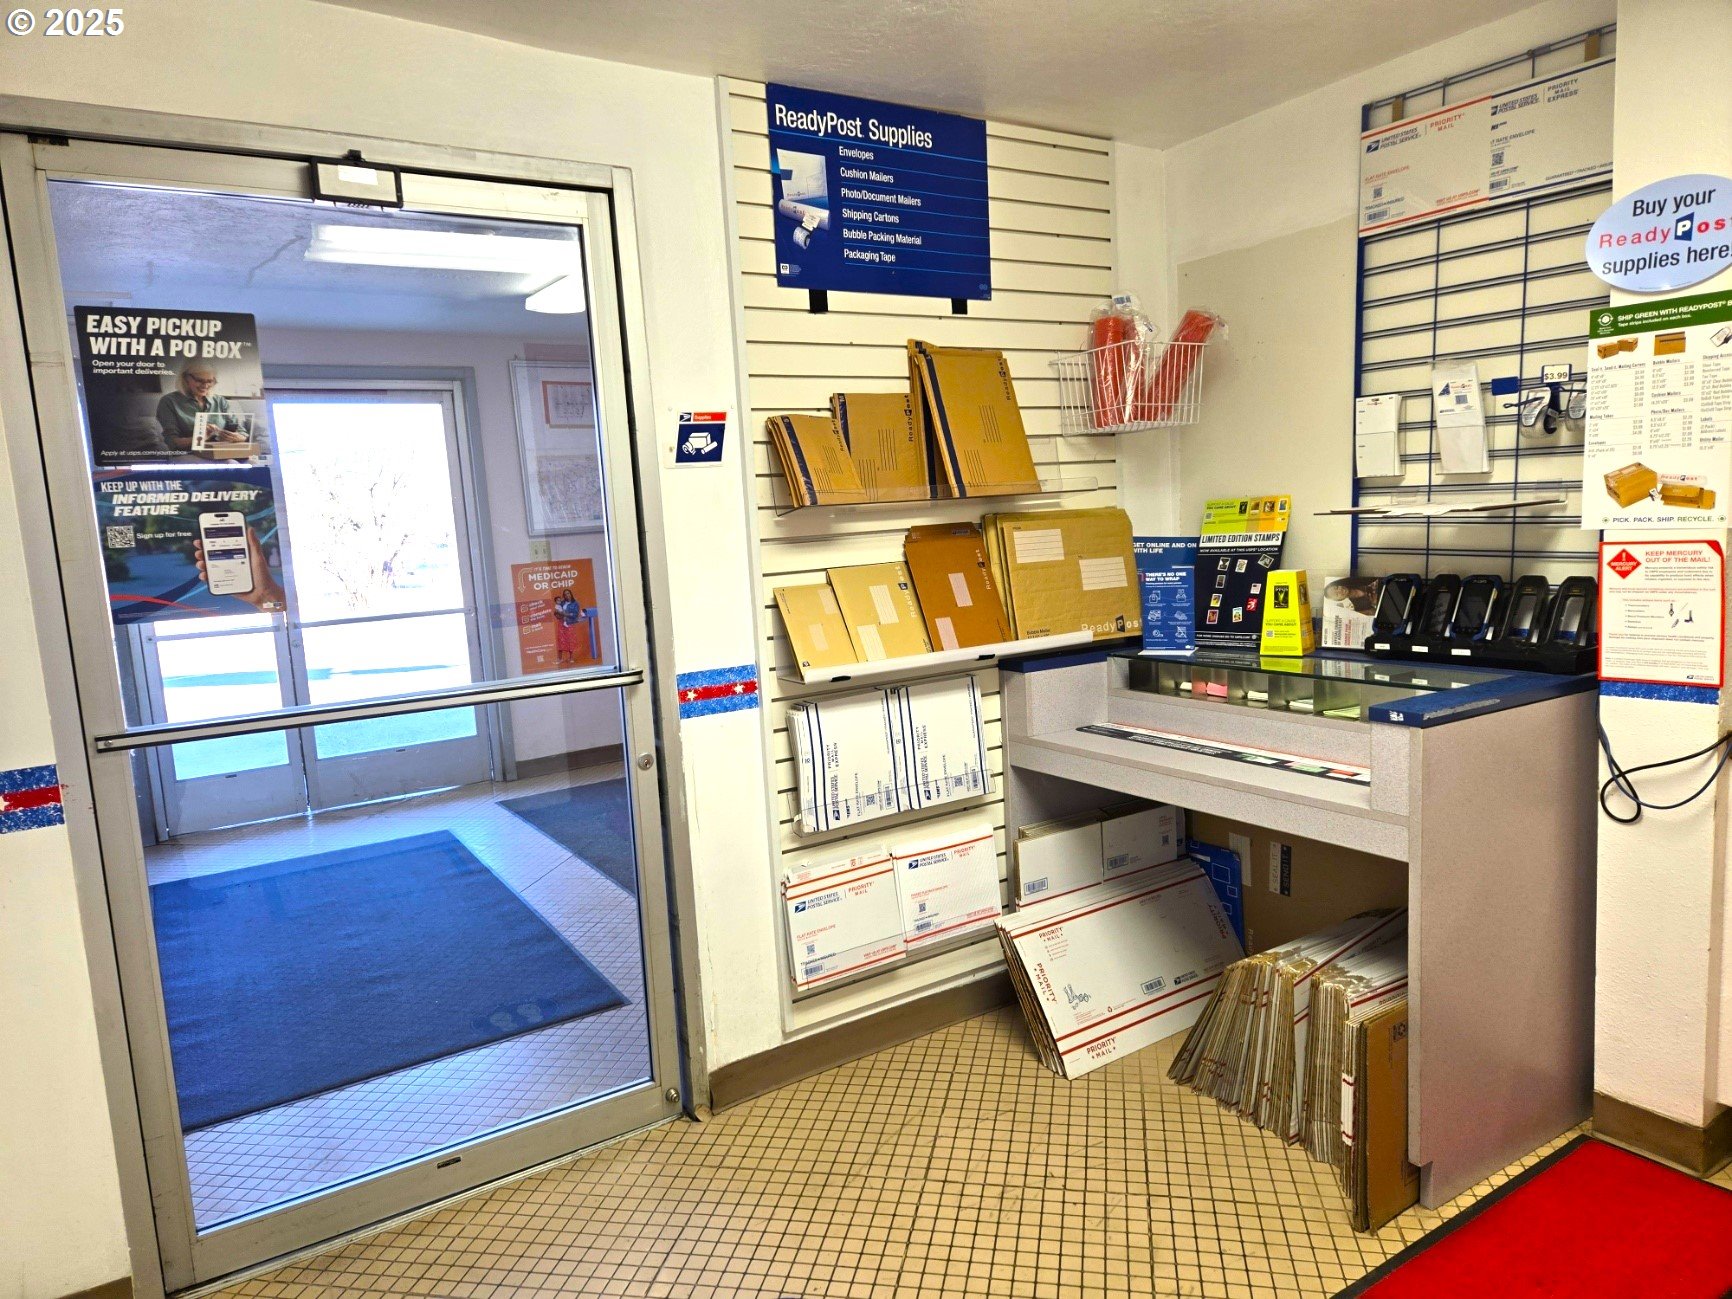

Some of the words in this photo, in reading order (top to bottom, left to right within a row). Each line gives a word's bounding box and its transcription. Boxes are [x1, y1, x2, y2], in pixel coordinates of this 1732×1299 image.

[1548, 78, 1579, 92] PRIORITY
[1547, 89, 1579, 103] EXPRESS
[775, 103, 863, 138] ReadyPost
[868, 118, 933, 149] Supplies
[1437, 123, 1454, 131] MAIL
[839, 146, 874, 161] Envelopes
[840, 166, 868, 181] Cushion
[869, 170, 894, 184] Mailers
[841, 187, 897, 204] Photo/Document
[897, 194, 922, 207] Mailers
[1632, 198, 1668, 218] Buy
[1672, 188, 1717, 214] your
[842, 208, 873, 222] Shipping
[874, 211, 900, 223] Cartons
[843, 228, 867, 241] Bubble
[868, 231, 895, 244] Packing
[896, 233, 922, 245] Material
[1599, 211, 1732, 249] ReadyPos
[844, 248, 879, 262] Packaging
[880, 251, 896, 263] Tape
[1601, 251, 1680, 276] supplies
[1617, 313, 1634, 322] SHIP
[1634, 310, 1658, 320] GREEN
[1659, 308, 1678, 316] WITH
[86, 314, 143, 335] EASY
[146, 316, 222, 339] PICKUP
[89, 336, 145, 356] WITH
[150, 338, 165, 357] A
[170, 339, 198, 358] PO
[92, 359, 115, 368] Open
[136, 360, 155, 368] door
[93, 367, 133, 376] important
[135, 368, 177, 376] deliveries.
[1544, 371, 1568, 381] $3.99
[904, 394, 915, 442] ReadyPost
[100, 481, 124, 492] KEEP
[125, 481, 138, 492] UP
[139, 480, 163, 491] WITH
[164, 480, 183, 490] THE
[112, 491, 189, 505] INFORMED
[113, 504, 180, 517] FEATURE
[136, 532, 153, 540] Sign
[154, 532, 164, 540] up
[1201, 535, 1227, 544] LIMITED
[1227, 534, 1252, 543] EDITION
[1253, 533, 1280, 542] STAMPS
[528, 570, 578, 582] MEDICAID
[533, 582, 549, 590] OR
[551, 580, 575, 589] CHIP
[848, 882, 873, 892] PRIORITY
[855, 888, 868, 896] MAIL
[1038, 926, 1063, 939] PRIORITY
[1047, 932, 1061, 942] MAIL
[1036, 974, 1047, 996] MAIL
[1037, 962, 1057, 1003] PRIORITY
[1086, 1035, 1117, 1055] PRIORITY
[1096, 1047, 1112, 1060] MAIL
